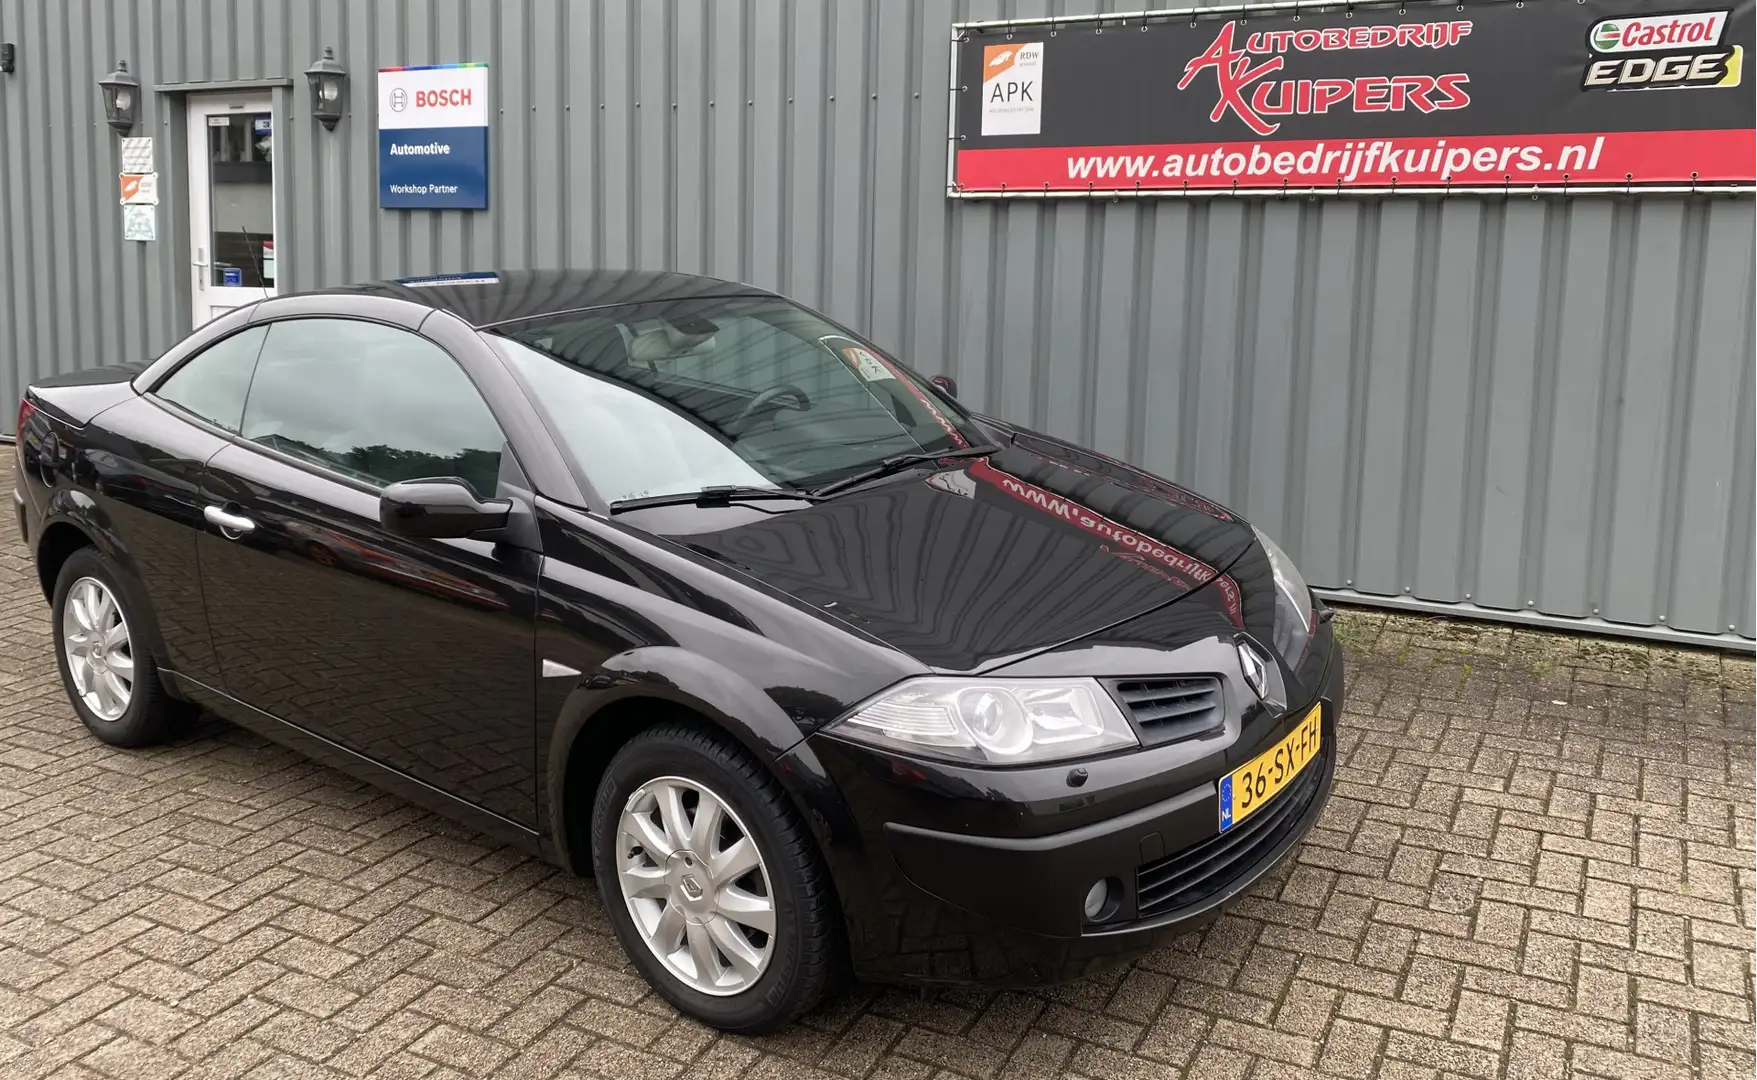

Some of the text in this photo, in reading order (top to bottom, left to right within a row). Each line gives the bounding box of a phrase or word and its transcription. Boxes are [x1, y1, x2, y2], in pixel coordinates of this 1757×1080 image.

[1622, 17, 1716, 47] Castrol
[1020, 51, 1040, 60] RDW
[1177, 20, 1473, 90] AUTOBEDRIJF
[1584, 53, 1729, 87] EDGE
[415, 88, 472, 108] BOSCH
[990, 81, 1034, 103] APK
[1210, 56, 1471, 136] KUIPERS
[390, 142, 451, 156] Automotive
[1067, 136, 1605, 182] www.autobedrijfkuipers.nl
[390, 184, 458, 195] Workshop Partner
[1241, 715, 1317, 809] 36-SX-FH
[1221, 807, 1232, 822] NL
